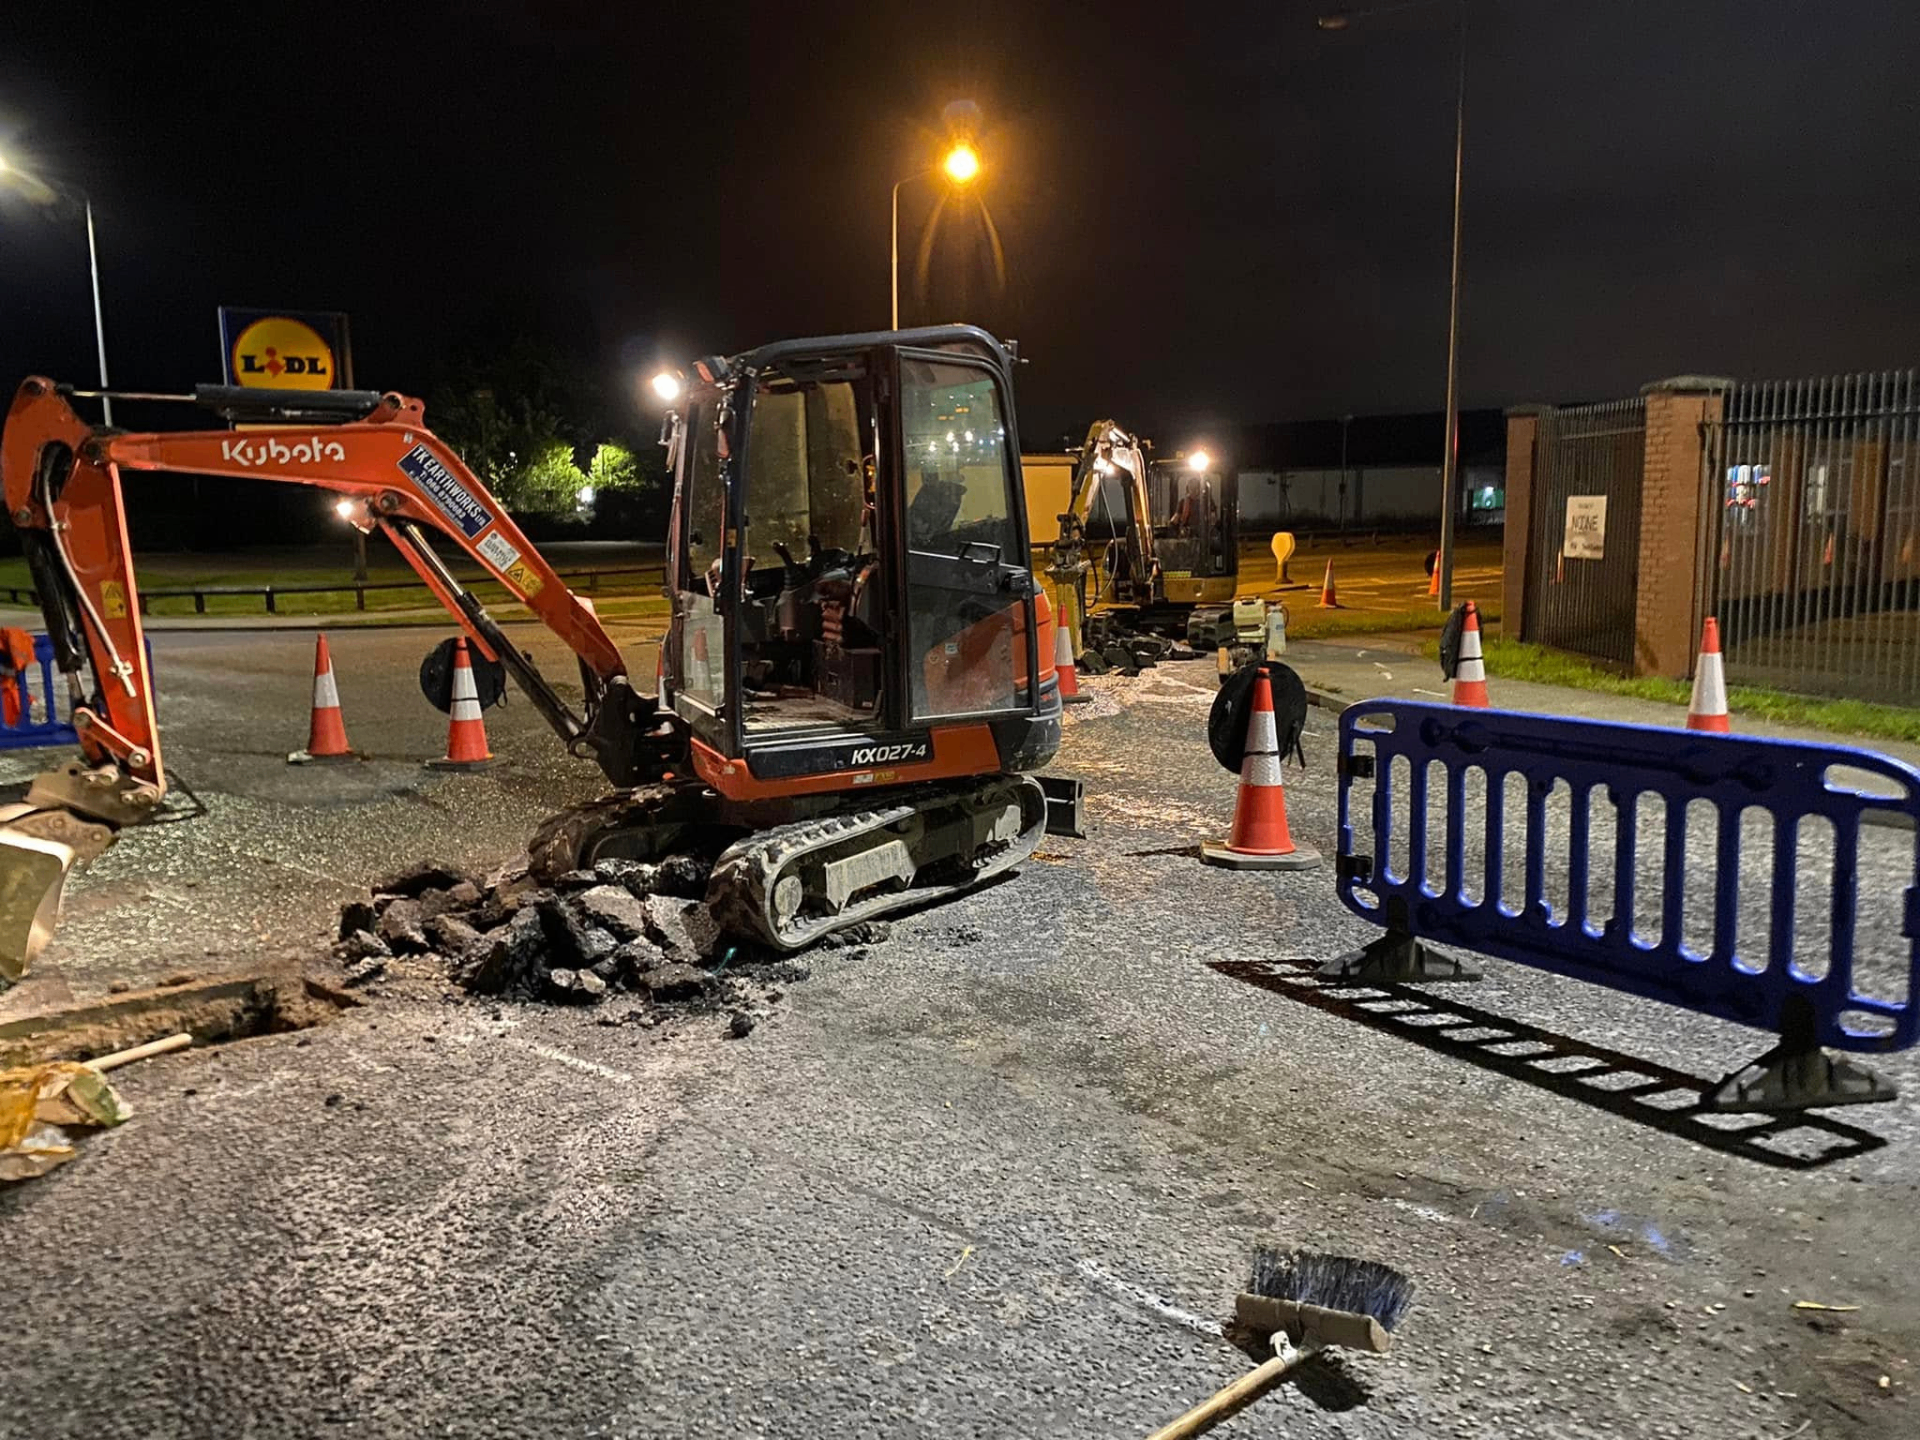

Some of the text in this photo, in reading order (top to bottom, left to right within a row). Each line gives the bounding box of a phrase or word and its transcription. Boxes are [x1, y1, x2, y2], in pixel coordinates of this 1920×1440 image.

[222, 436, 345, 466] Kubota
[412, 446, 430, 464] TK
[423, 458, 482, 518] EARTHWORKS
[851, 744, 927, 765] KX027-4
